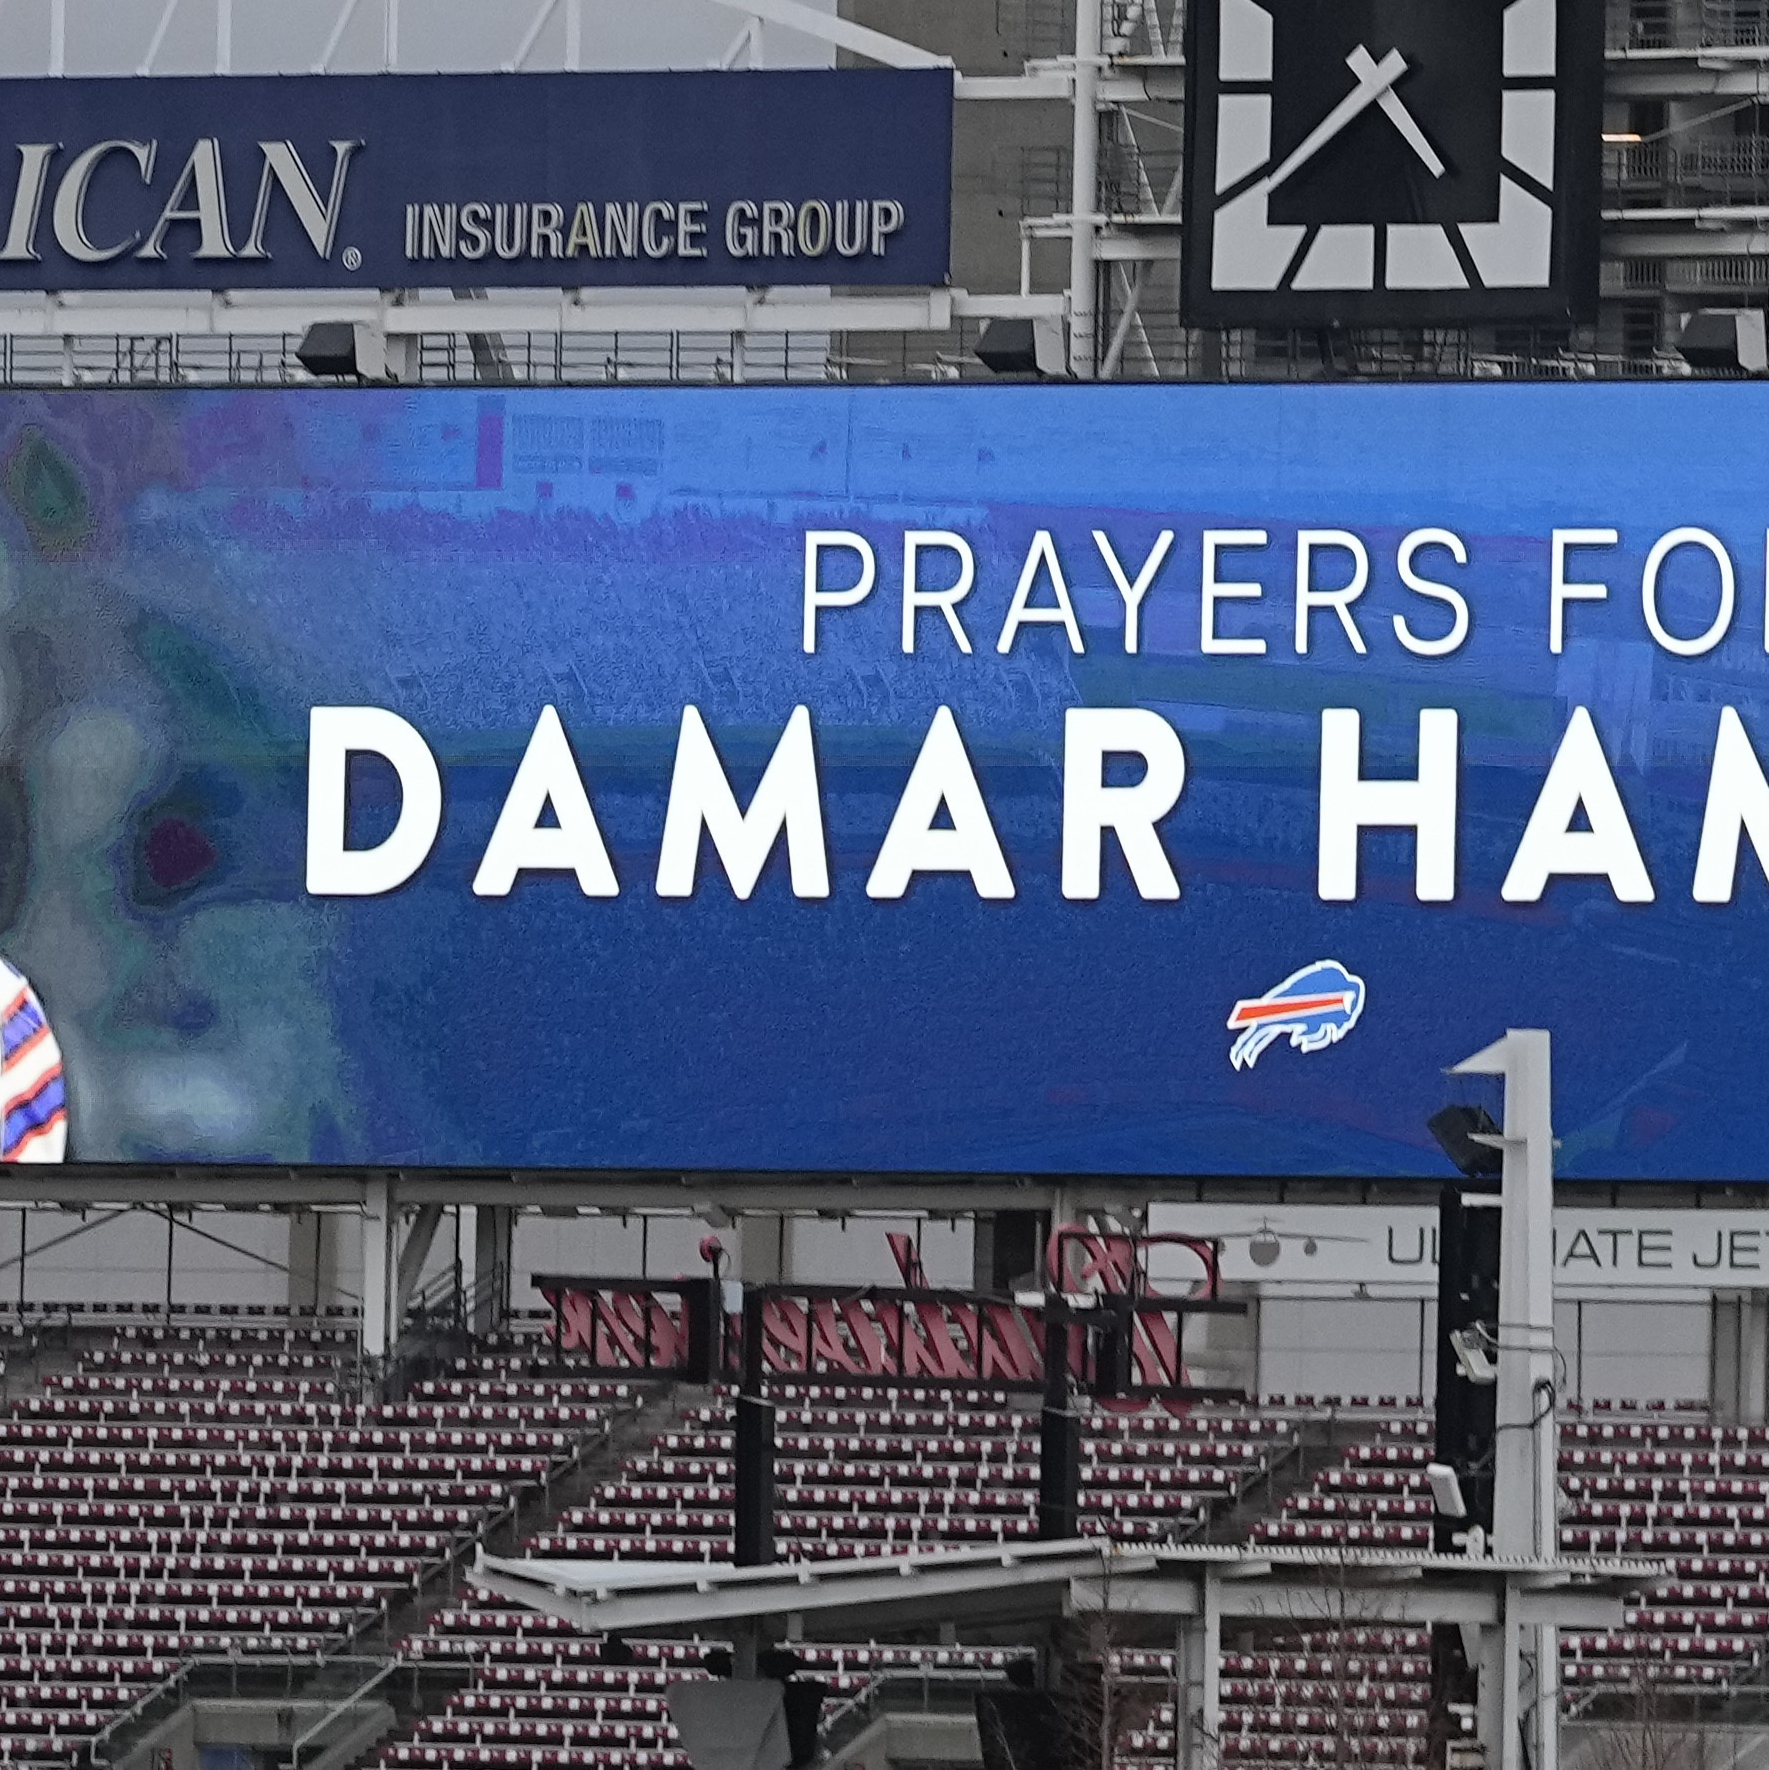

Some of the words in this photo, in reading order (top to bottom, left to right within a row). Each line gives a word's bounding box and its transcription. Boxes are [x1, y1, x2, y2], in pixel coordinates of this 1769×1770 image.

[404, 200, 709, 260] INSURANCE
[724, 198, 905, 258] GROUP
[804, 527, 1469, 656] PRAYERS
[306, 704, 1186, 901] DAMAR
